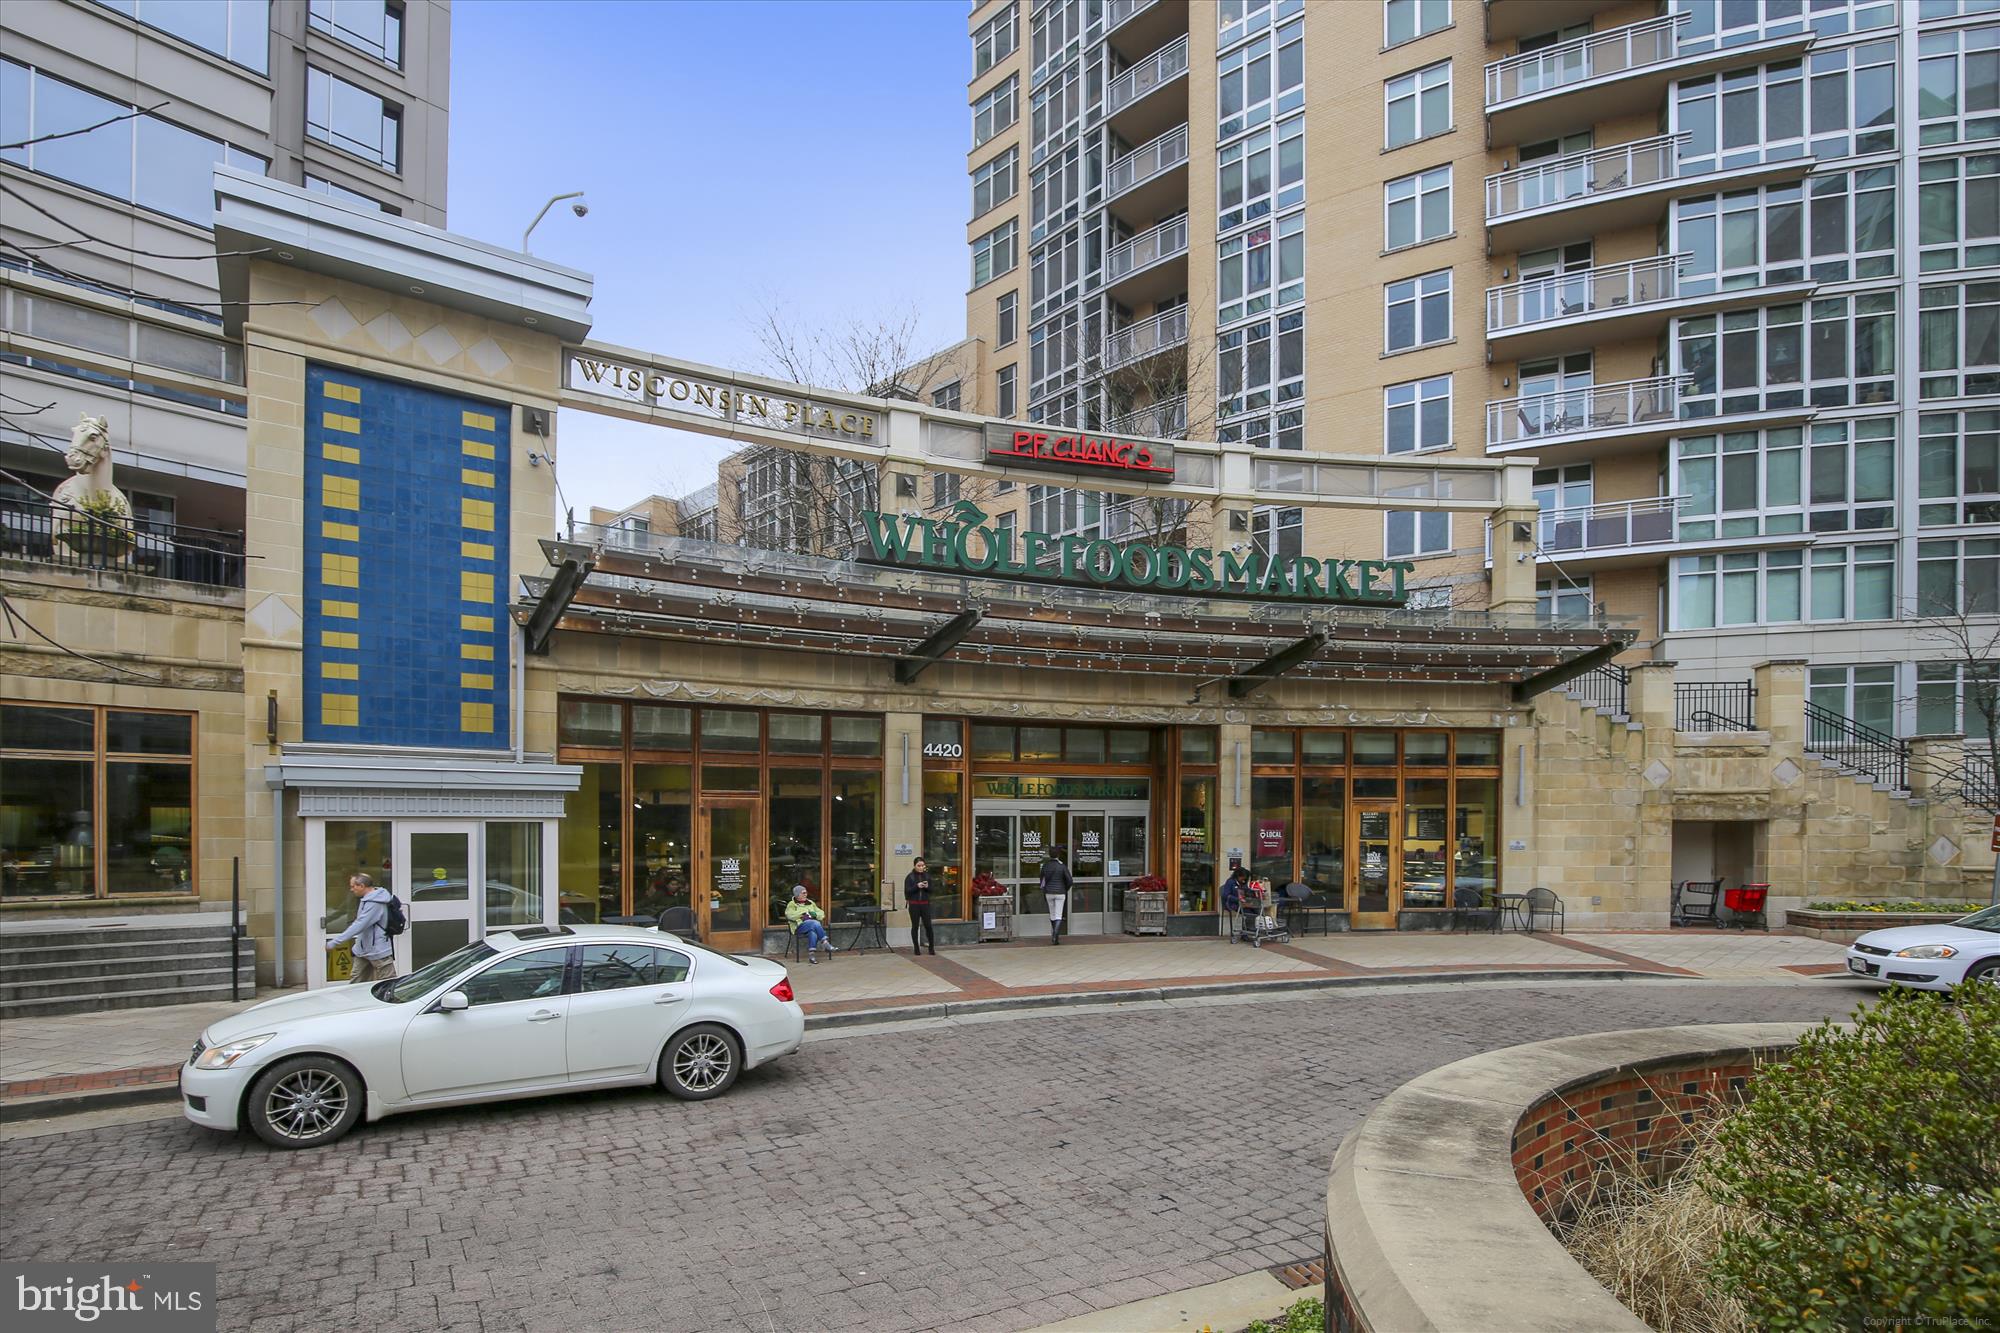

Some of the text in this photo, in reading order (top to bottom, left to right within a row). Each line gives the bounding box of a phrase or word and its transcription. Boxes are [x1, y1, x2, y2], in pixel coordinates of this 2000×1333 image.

[577, 357, 874, 437] WISCONSIN PLACE
[1013, 431, 1153, 469] P.F. CHANG'S
[859, 500, 1415, 601] WHOLE FOODS MARKET
[923, 743, 963, 758] 4420
[986, 777, 1035, 796] WHOLE
[1037, 783, 1081, 796] FOODS
